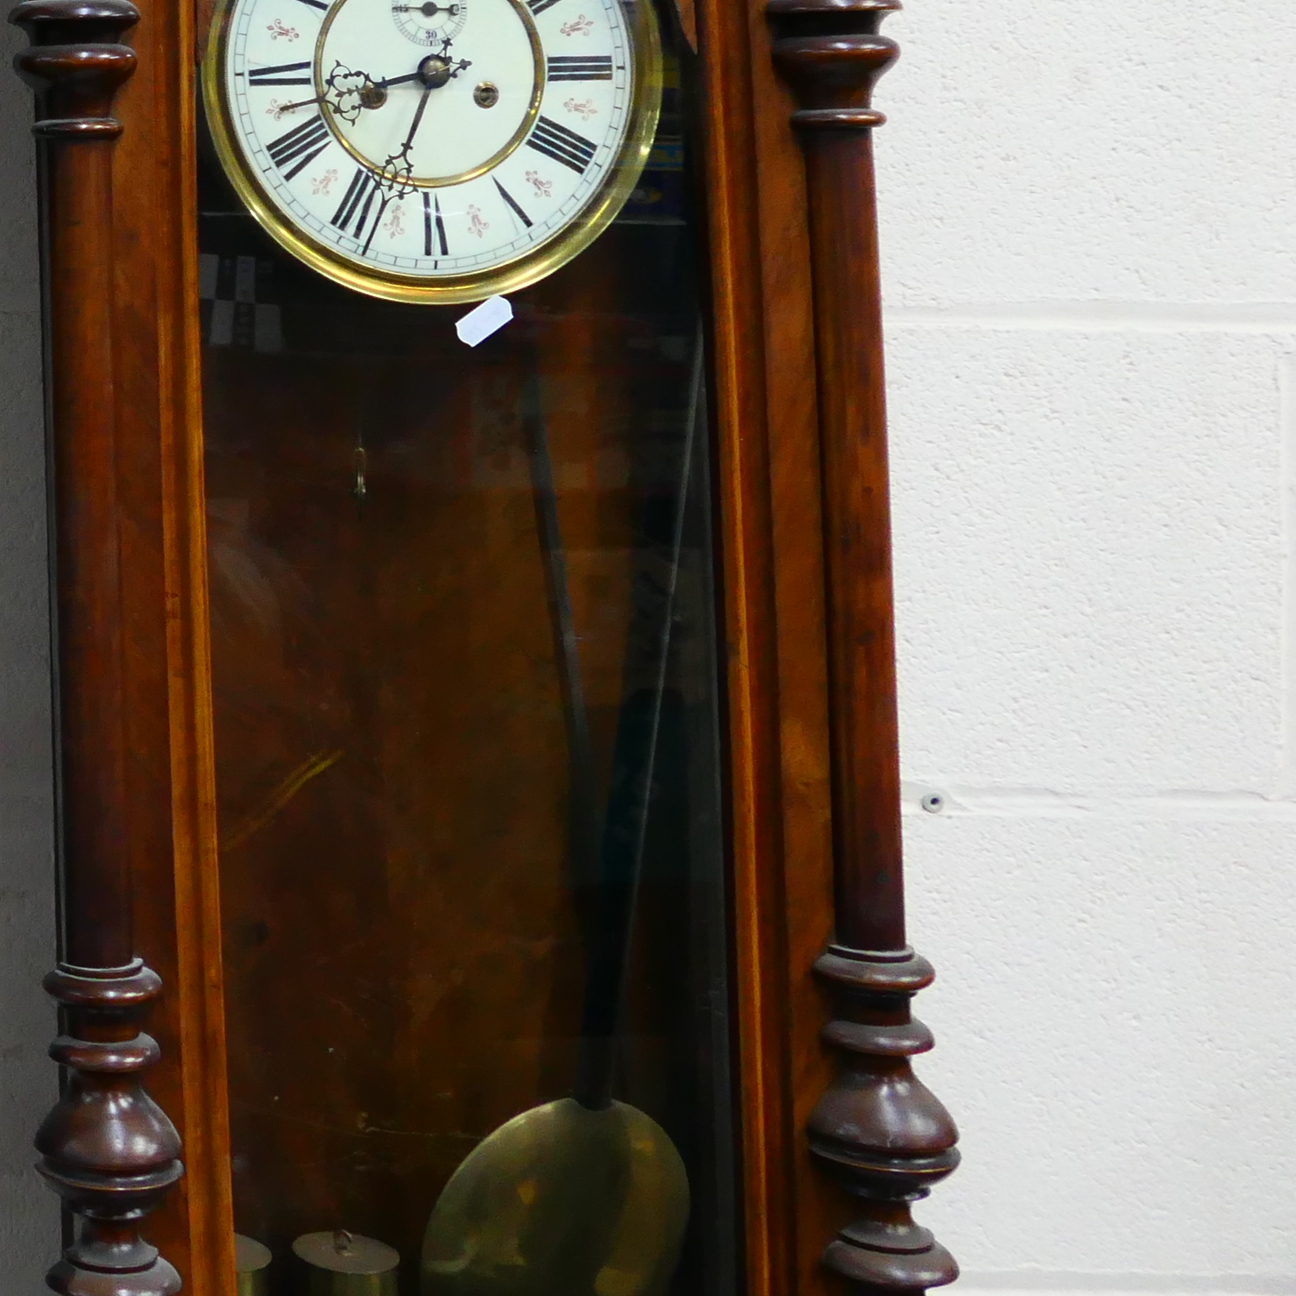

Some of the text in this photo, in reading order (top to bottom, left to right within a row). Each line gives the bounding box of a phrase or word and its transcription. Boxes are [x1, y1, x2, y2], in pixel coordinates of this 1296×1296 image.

[425, 30, 438, 39] 30
[547, 55, 613, 82] III
[265, 114, 332, 182] VIII
[423, 192, 449, 256] VI
[492, 175, 534, 235] V
